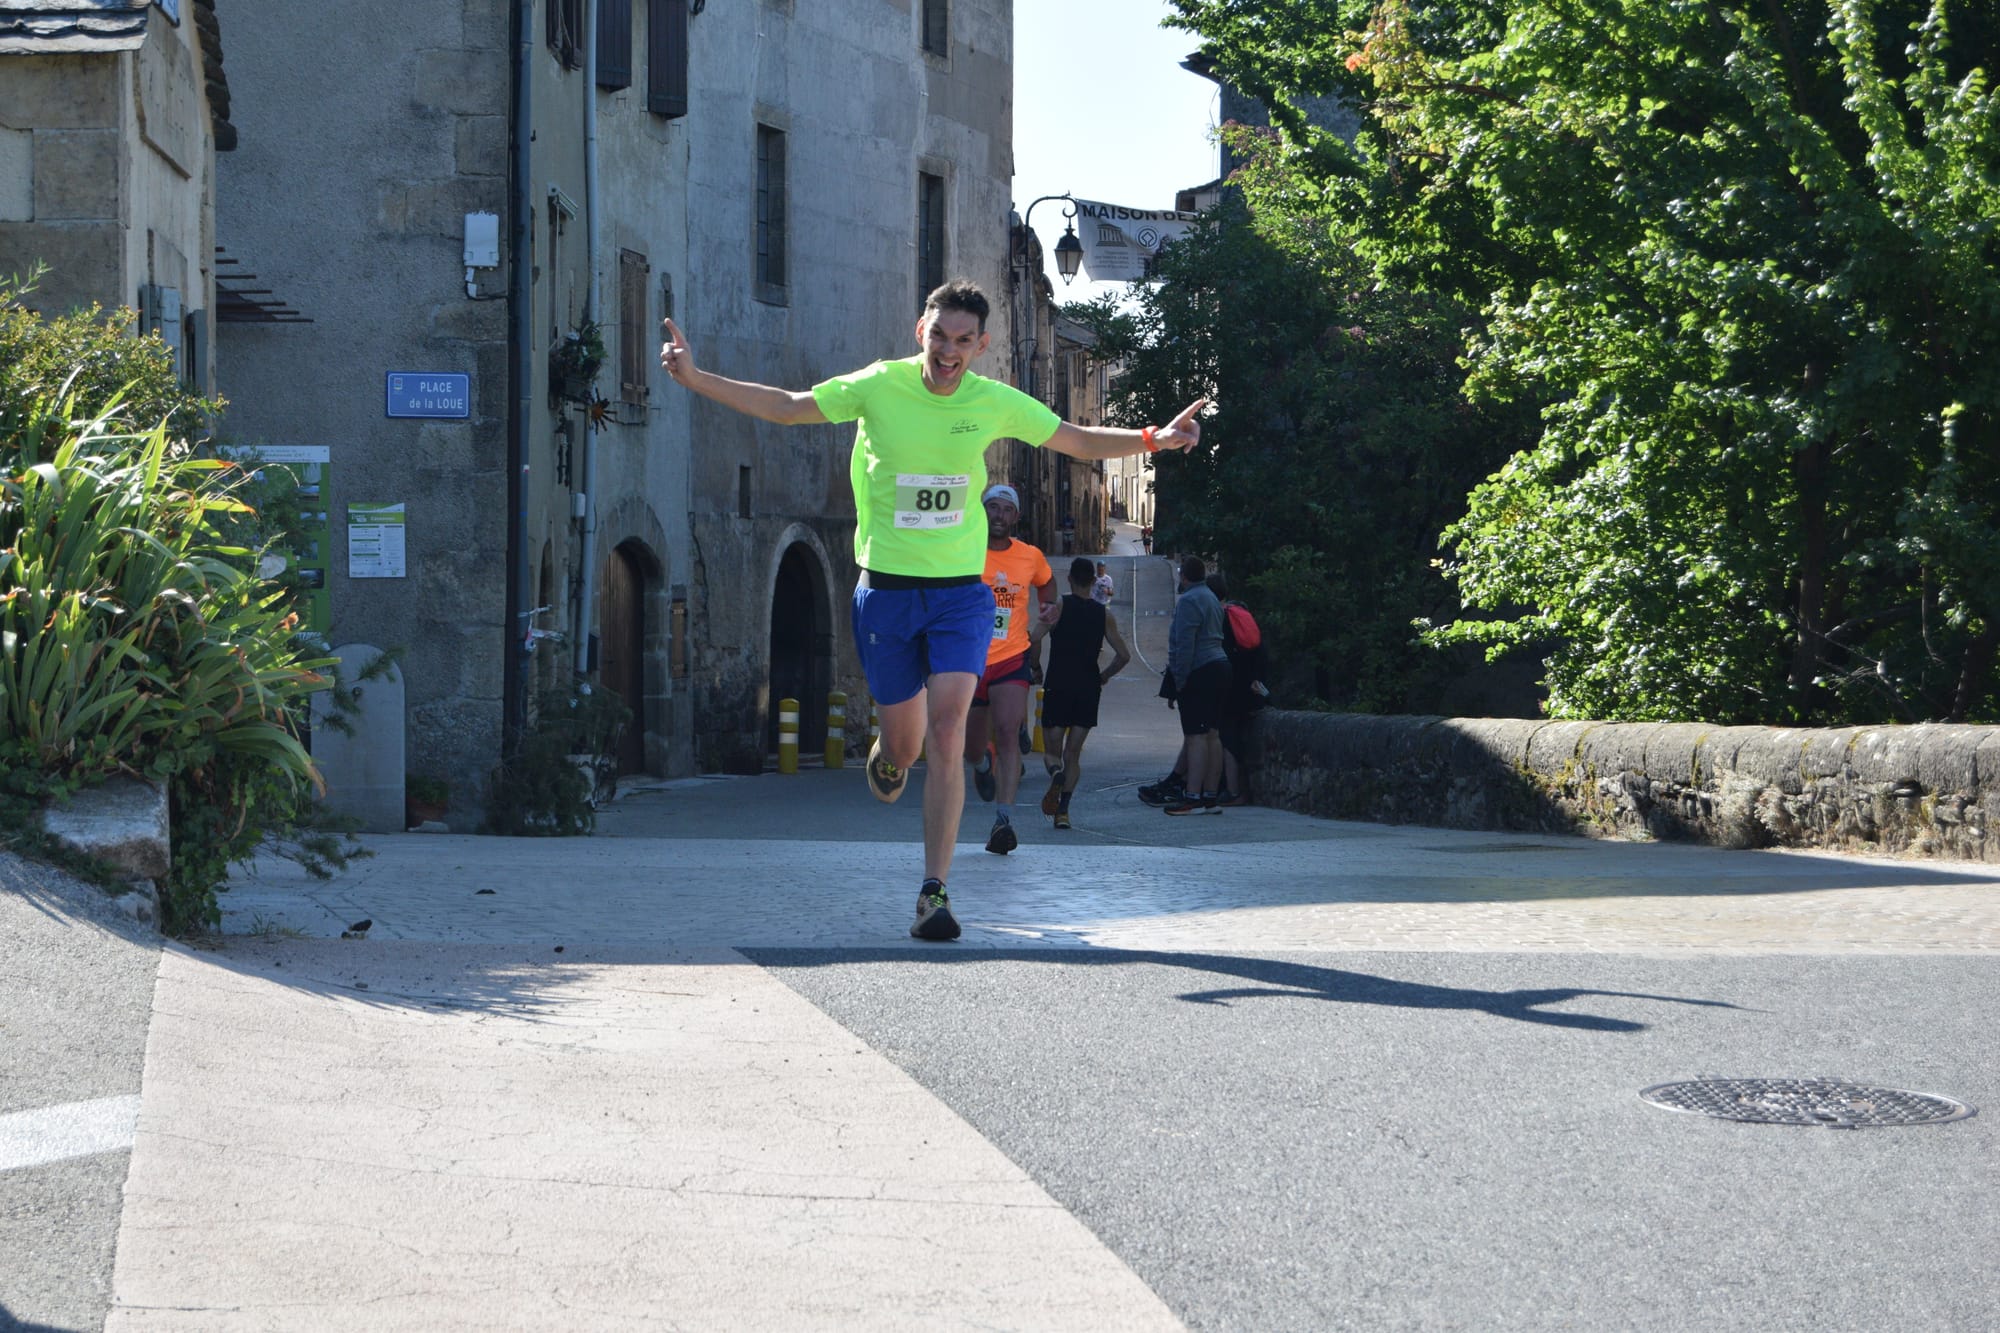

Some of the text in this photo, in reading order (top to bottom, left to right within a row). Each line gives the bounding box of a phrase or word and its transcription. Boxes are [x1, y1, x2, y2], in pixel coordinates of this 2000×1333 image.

[1082, 204, 1157, 221] MAISON
[420, 381, 453, 393] PLACE
[409, 398, 463, 409] de la LOUE
[916, 489, 951, 511] 80
